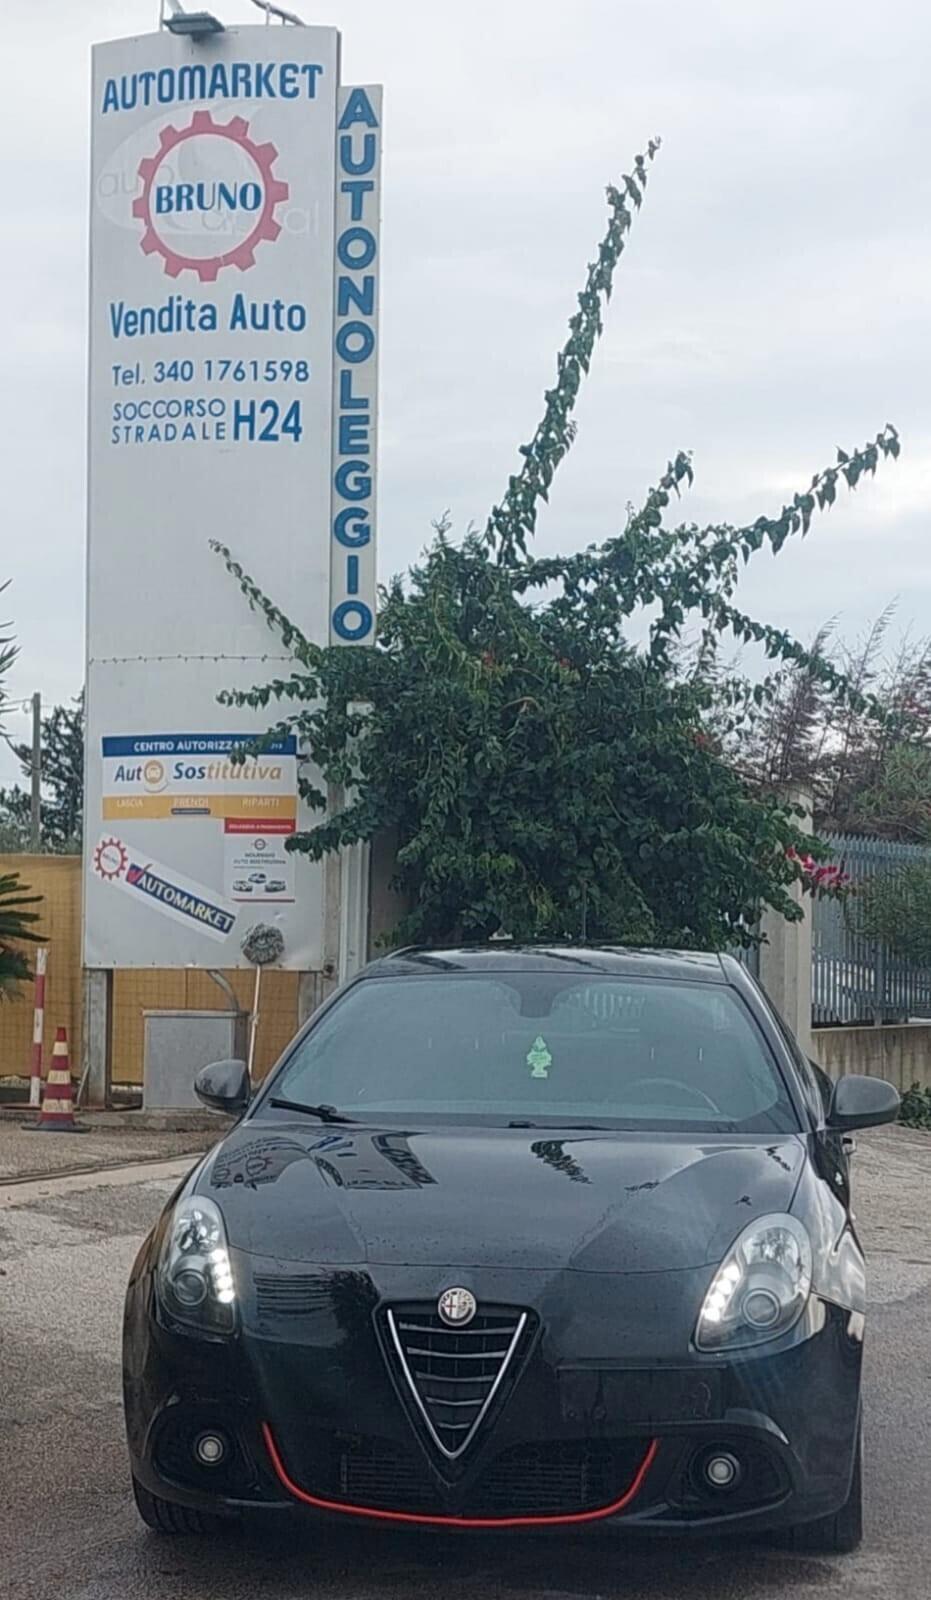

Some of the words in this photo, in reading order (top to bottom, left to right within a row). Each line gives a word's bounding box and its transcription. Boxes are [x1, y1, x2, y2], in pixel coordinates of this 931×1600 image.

[102, 63, 323, 114] AUTOMARKET
[155, 182, 261, 213] BRUNO
[110, 295, 218, 338] Vendita
[229, 293, 306, 332] Auto
[112, 362, 145, 386] Tel.
[153, 360, 194, 383] 340
[205, 360, 310, 383] 1761598
[333, 87, 379, 641] AUTONOLEGGIO
[112, 398, 226, 422] SOCCORSO
[233, 399, 303, 443] H24
[111, 422, 226, 445] STRADALE
[134, 741, 174, 752] CENTRO
[173, 761, 282, 780] Sostitutiva
[136, 873, 233, 931] AUTOMARKET
